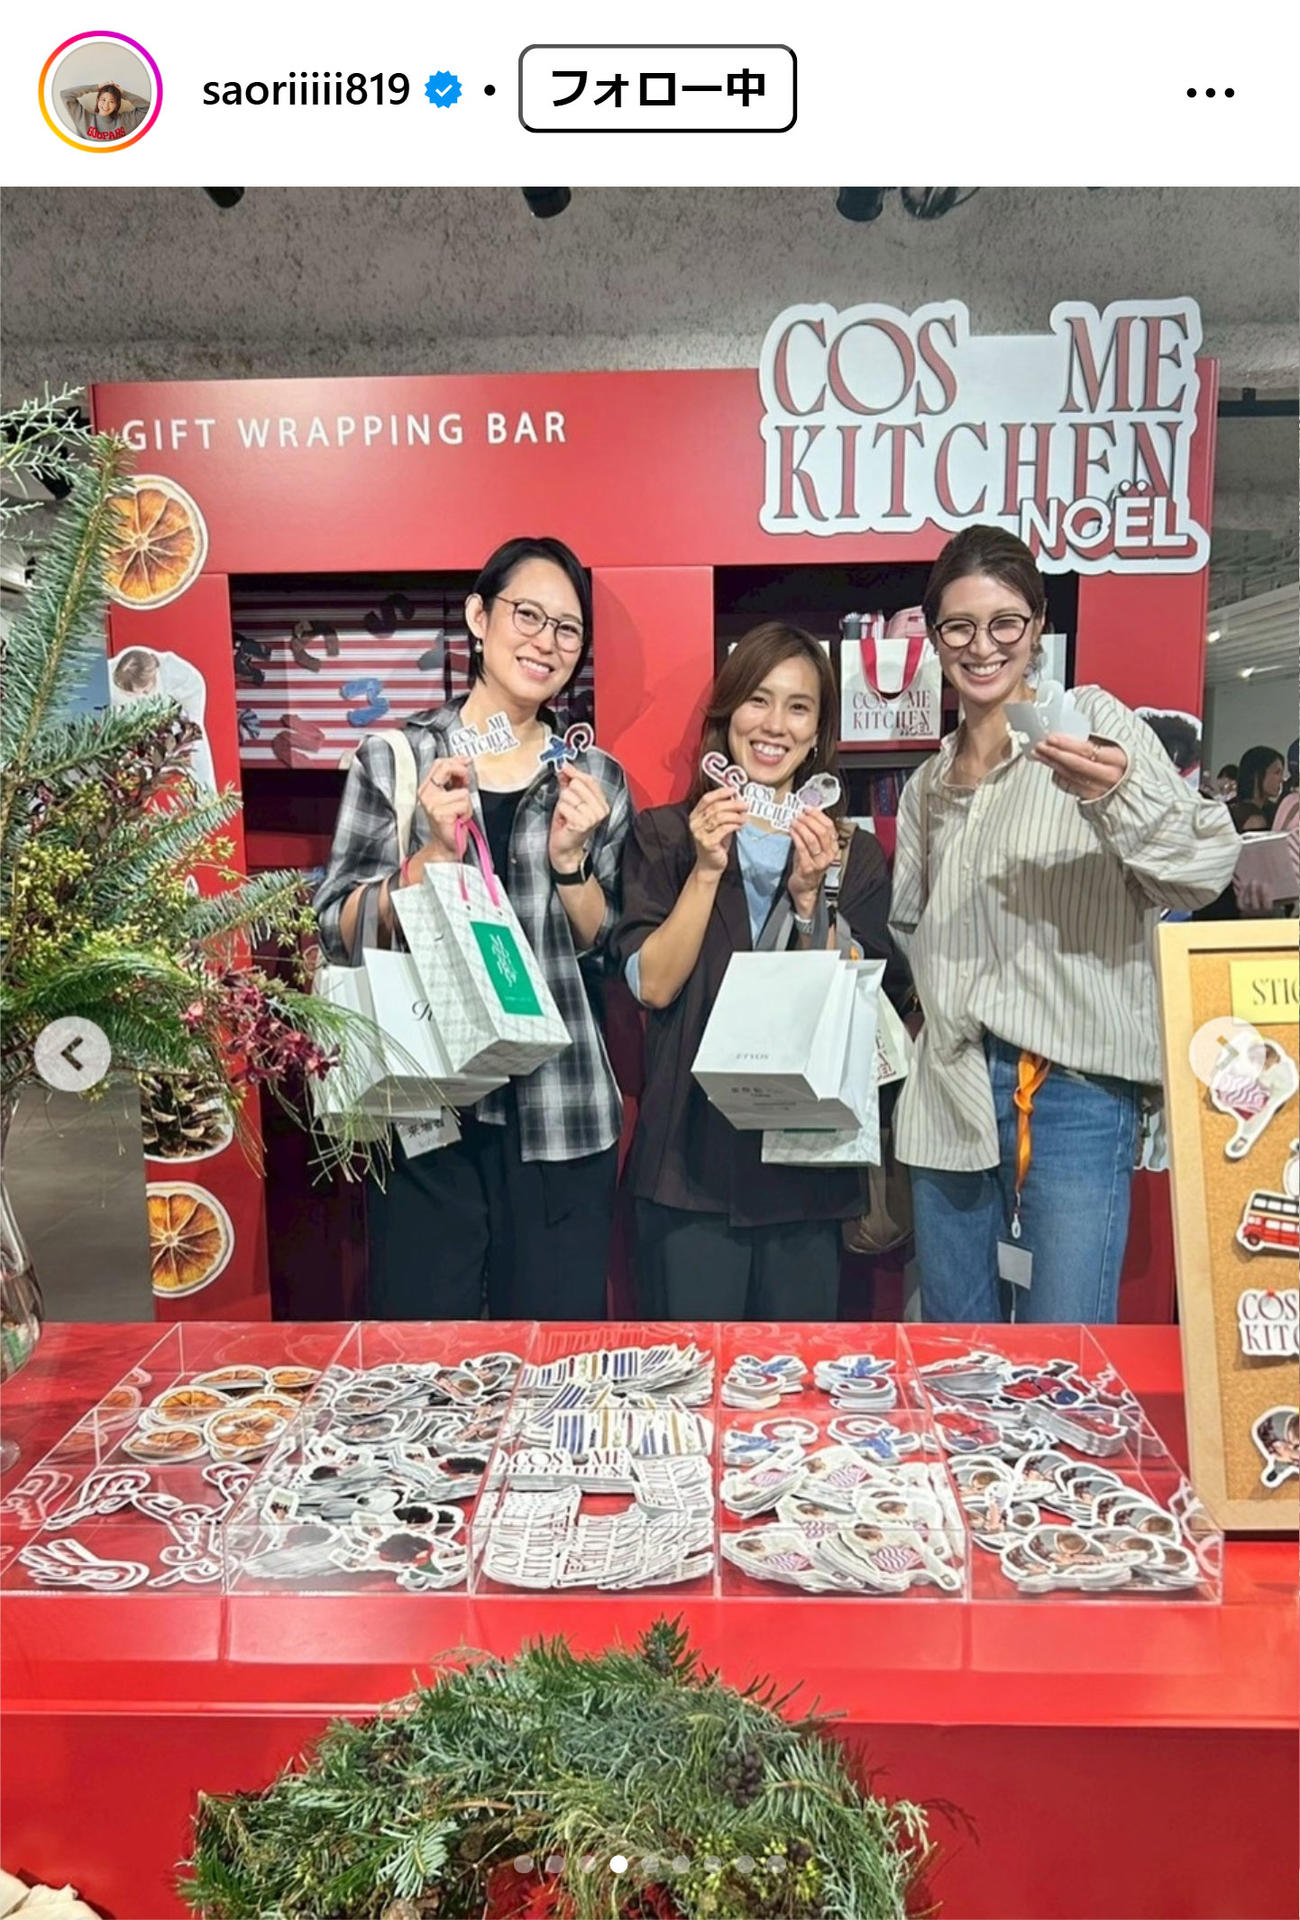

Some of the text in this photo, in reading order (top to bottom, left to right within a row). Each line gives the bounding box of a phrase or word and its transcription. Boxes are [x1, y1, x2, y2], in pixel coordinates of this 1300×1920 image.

[773, 313, 1189, 417] COS ME
[121, 411, 566, 451] GIFT WRAPPING BAR
[773, 420, 1183, 521] KITCHEN
[1021, 480, 1189, 550] NOËL
